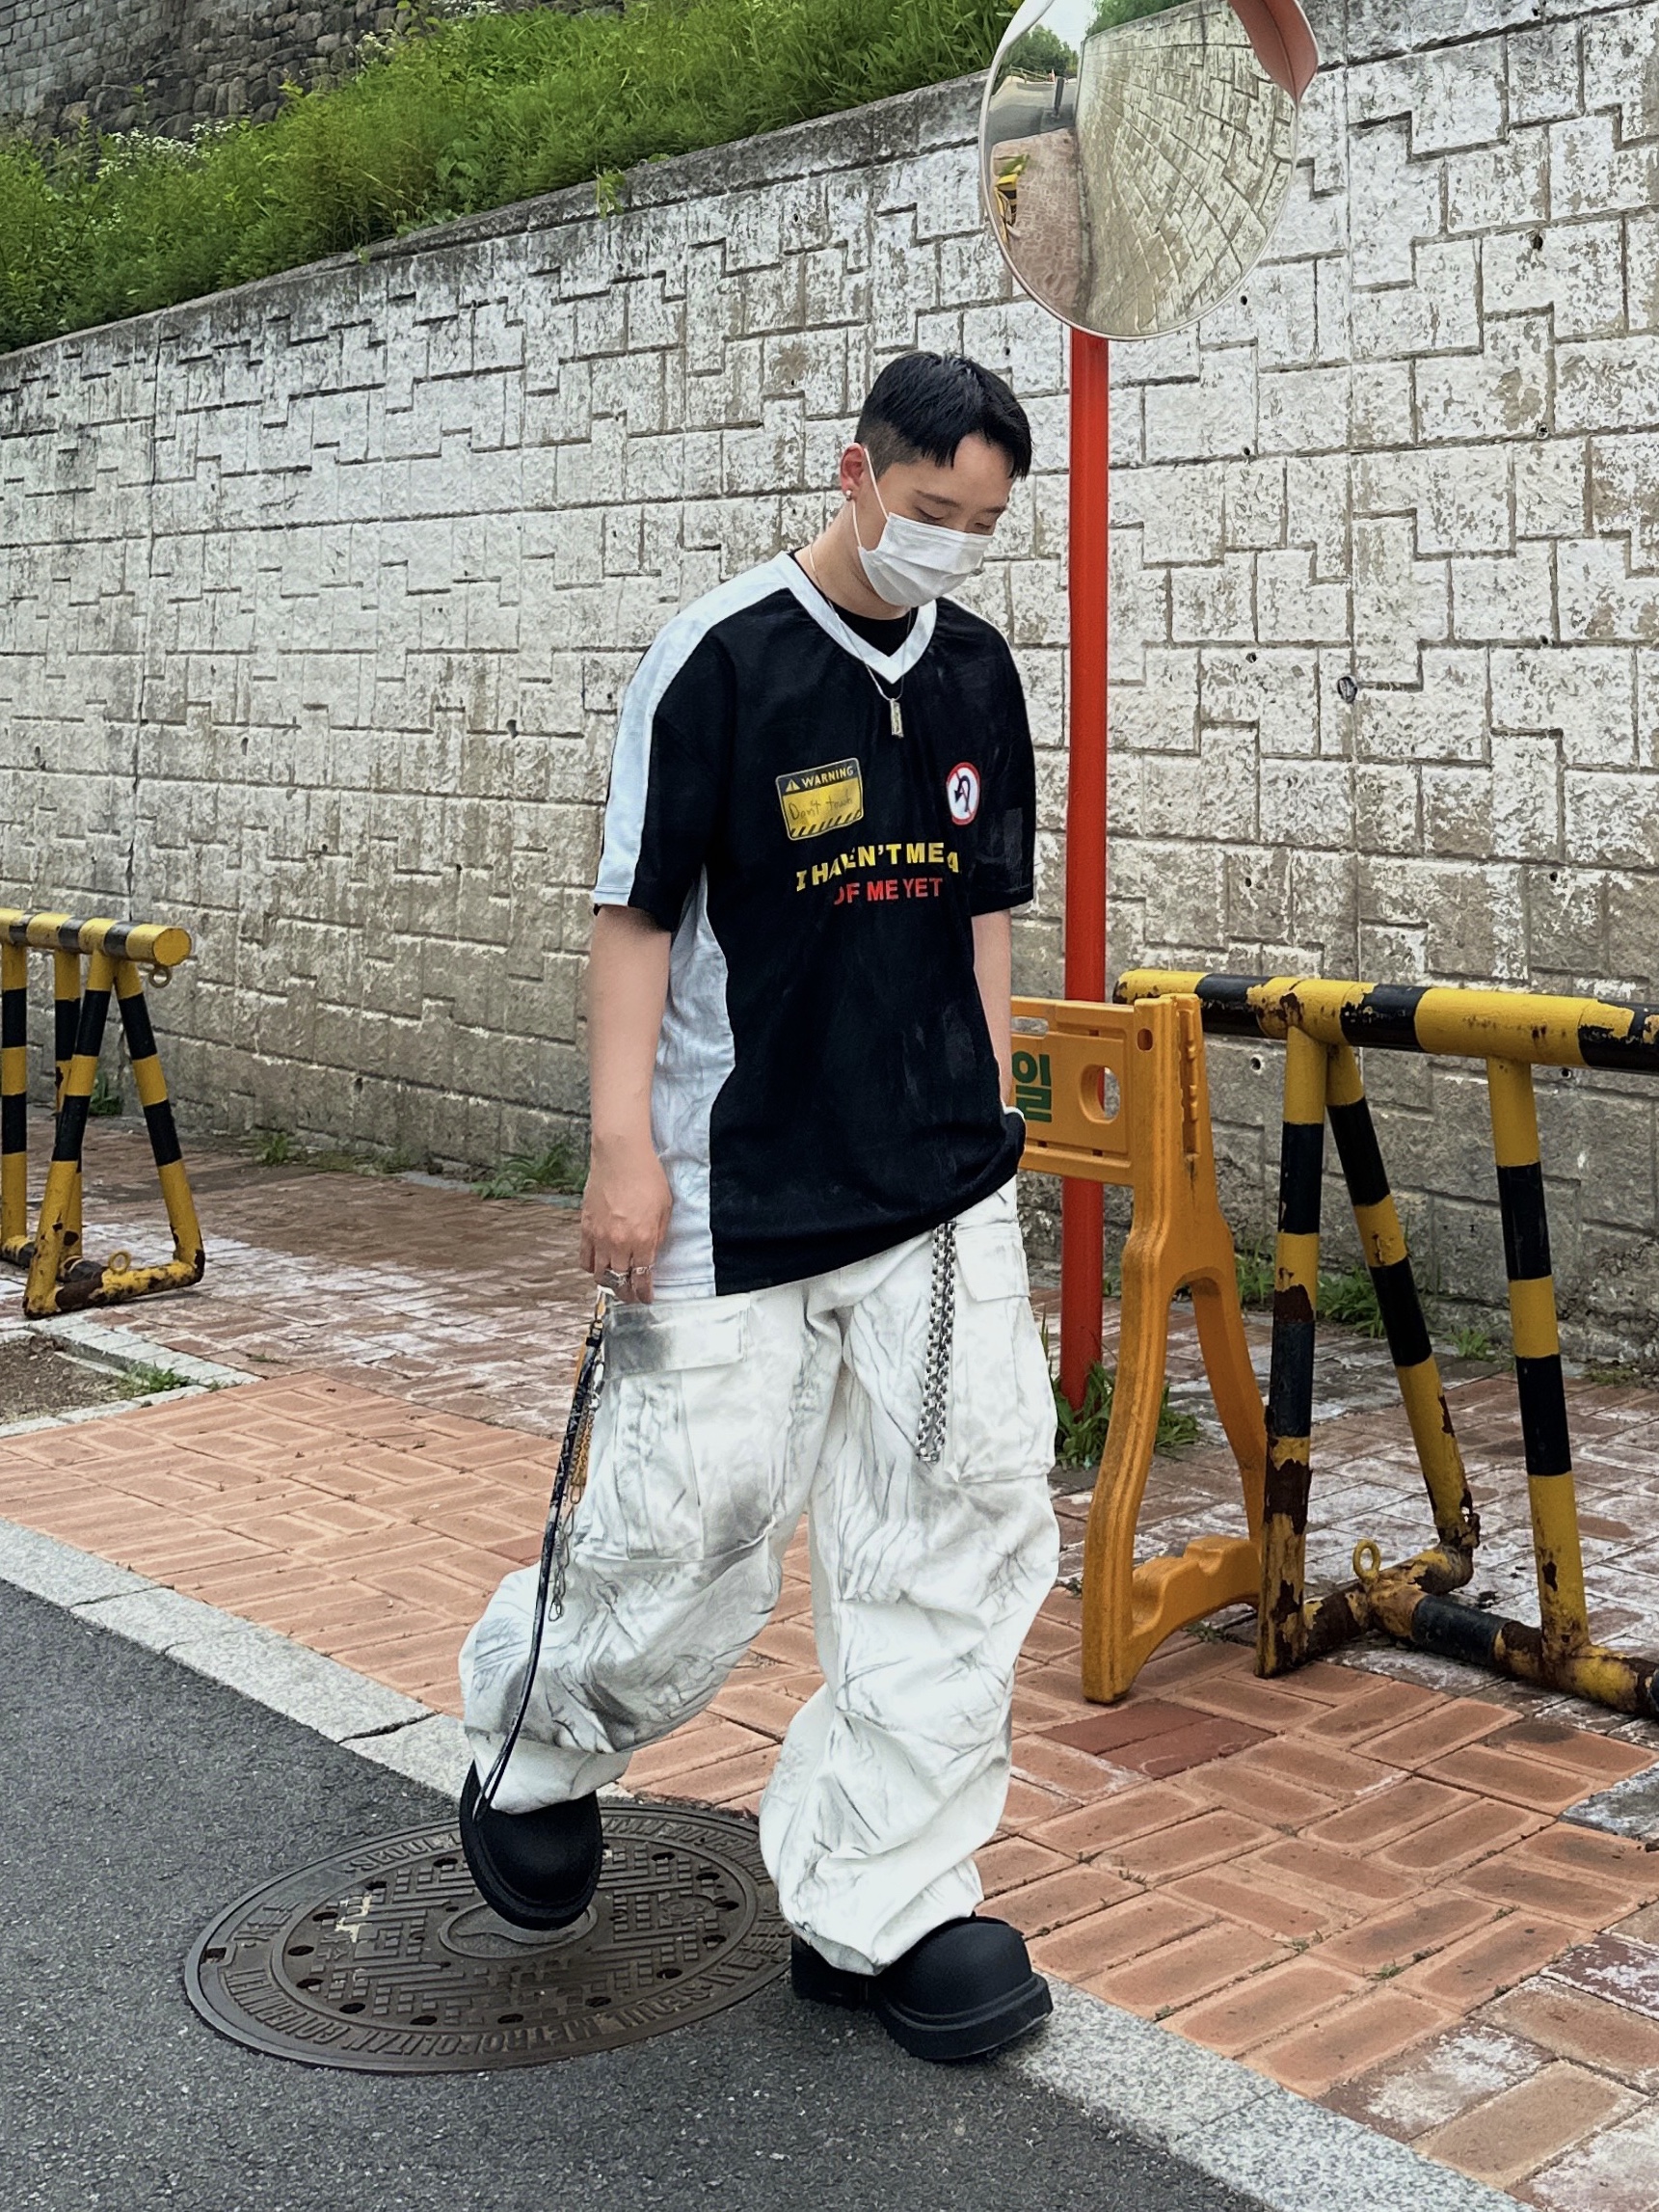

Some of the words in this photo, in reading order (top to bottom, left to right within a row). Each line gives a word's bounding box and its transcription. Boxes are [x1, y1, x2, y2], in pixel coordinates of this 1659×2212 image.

[801, 766, 854, 788] WARNING
[796, 870, 807, 892] I
[868, 878, 898, 902] ME
[903, 877, 943, 899] YET
